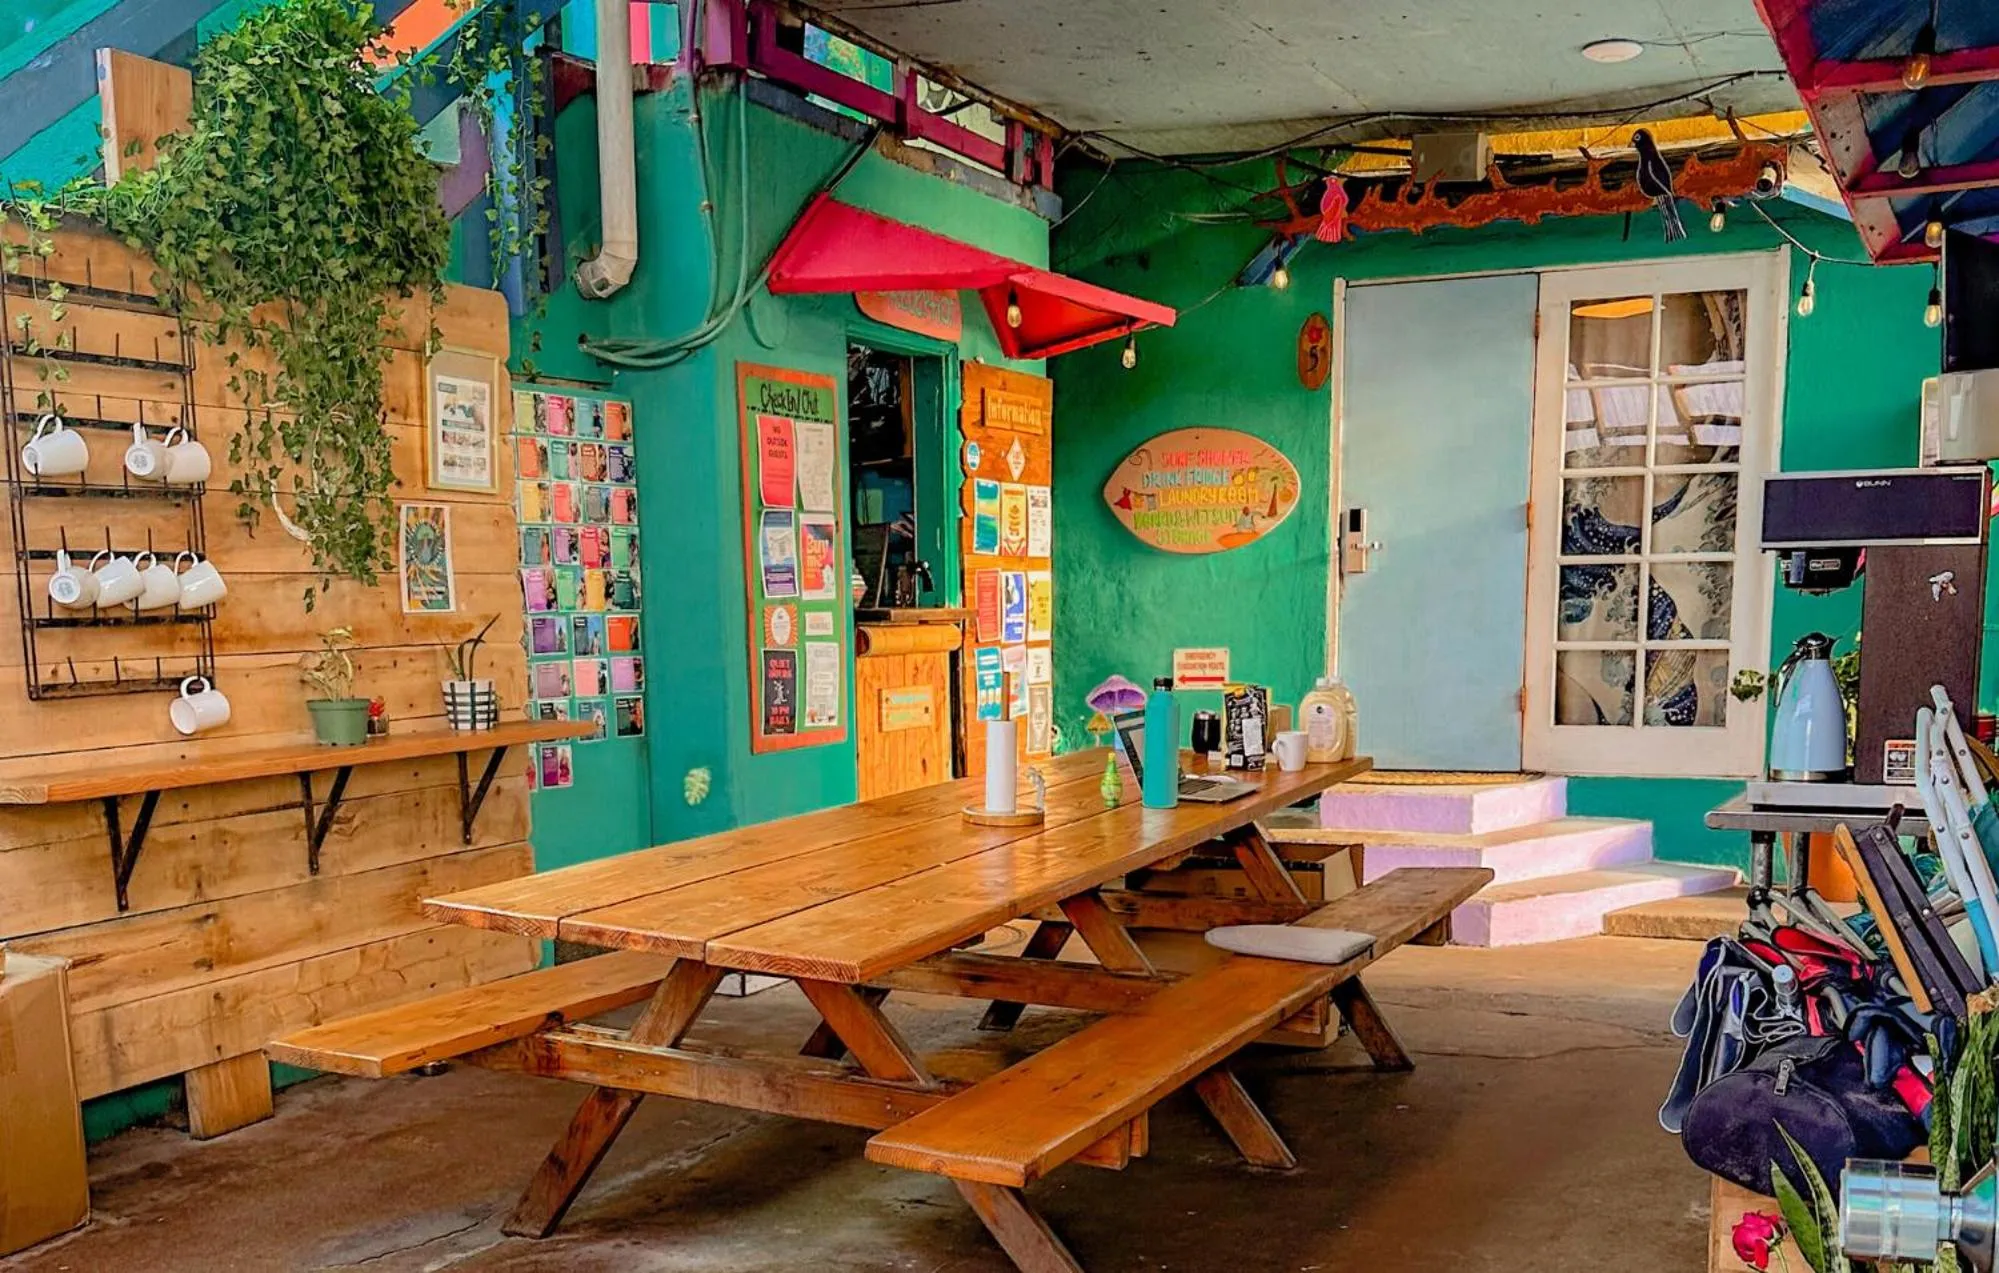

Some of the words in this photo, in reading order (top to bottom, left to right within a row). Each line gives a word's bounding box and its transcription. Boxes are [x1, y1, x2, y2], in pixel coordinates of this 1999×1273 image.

[1142, 470, 1181, 488] DRINK
[1185, 468, 1231, 486] FRIDGE
[1184, 652, 1216, 660] EMERGENCY
[768, 659, 790, 669] QUIET
